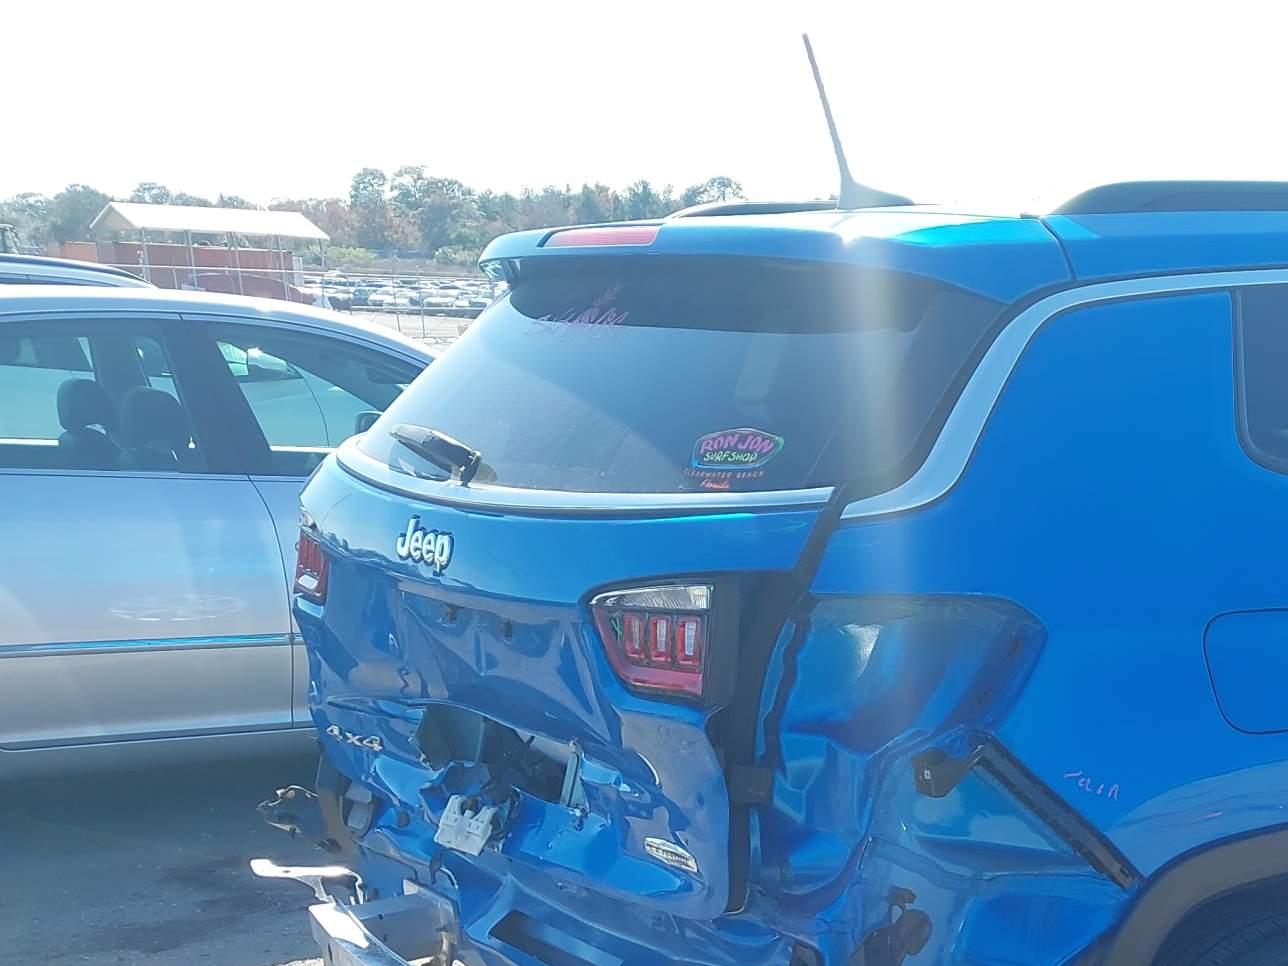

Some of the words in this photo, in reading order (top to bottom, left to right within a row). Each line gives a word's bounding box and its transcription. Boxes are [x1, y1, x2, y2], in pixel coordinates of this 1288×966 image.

[700, 434, 738, 454] RON
[739, 434, 774, 453] JON
[397, 514, 454, 576] Jeep
